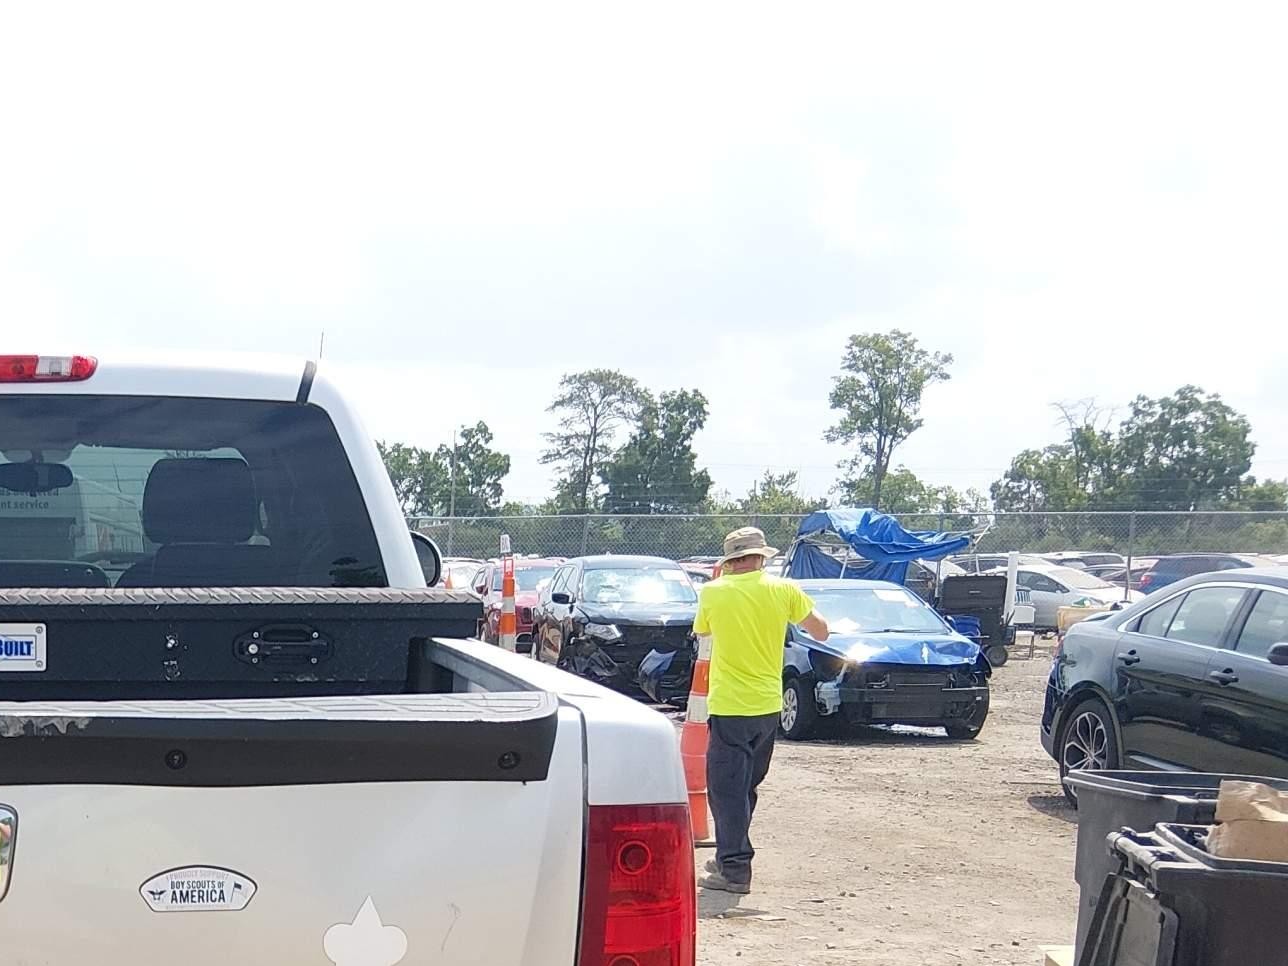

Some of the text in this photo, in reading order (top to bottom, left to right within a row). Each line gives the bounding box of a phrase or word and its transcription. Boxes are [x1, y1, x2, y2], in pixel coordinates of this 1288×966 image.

[13, 498, 50, 510] service
[170, 880, 185, 890] BOY
[186, 880, 216, 889] SCOUTS
[170, 889, 226, 904] AMERICA
